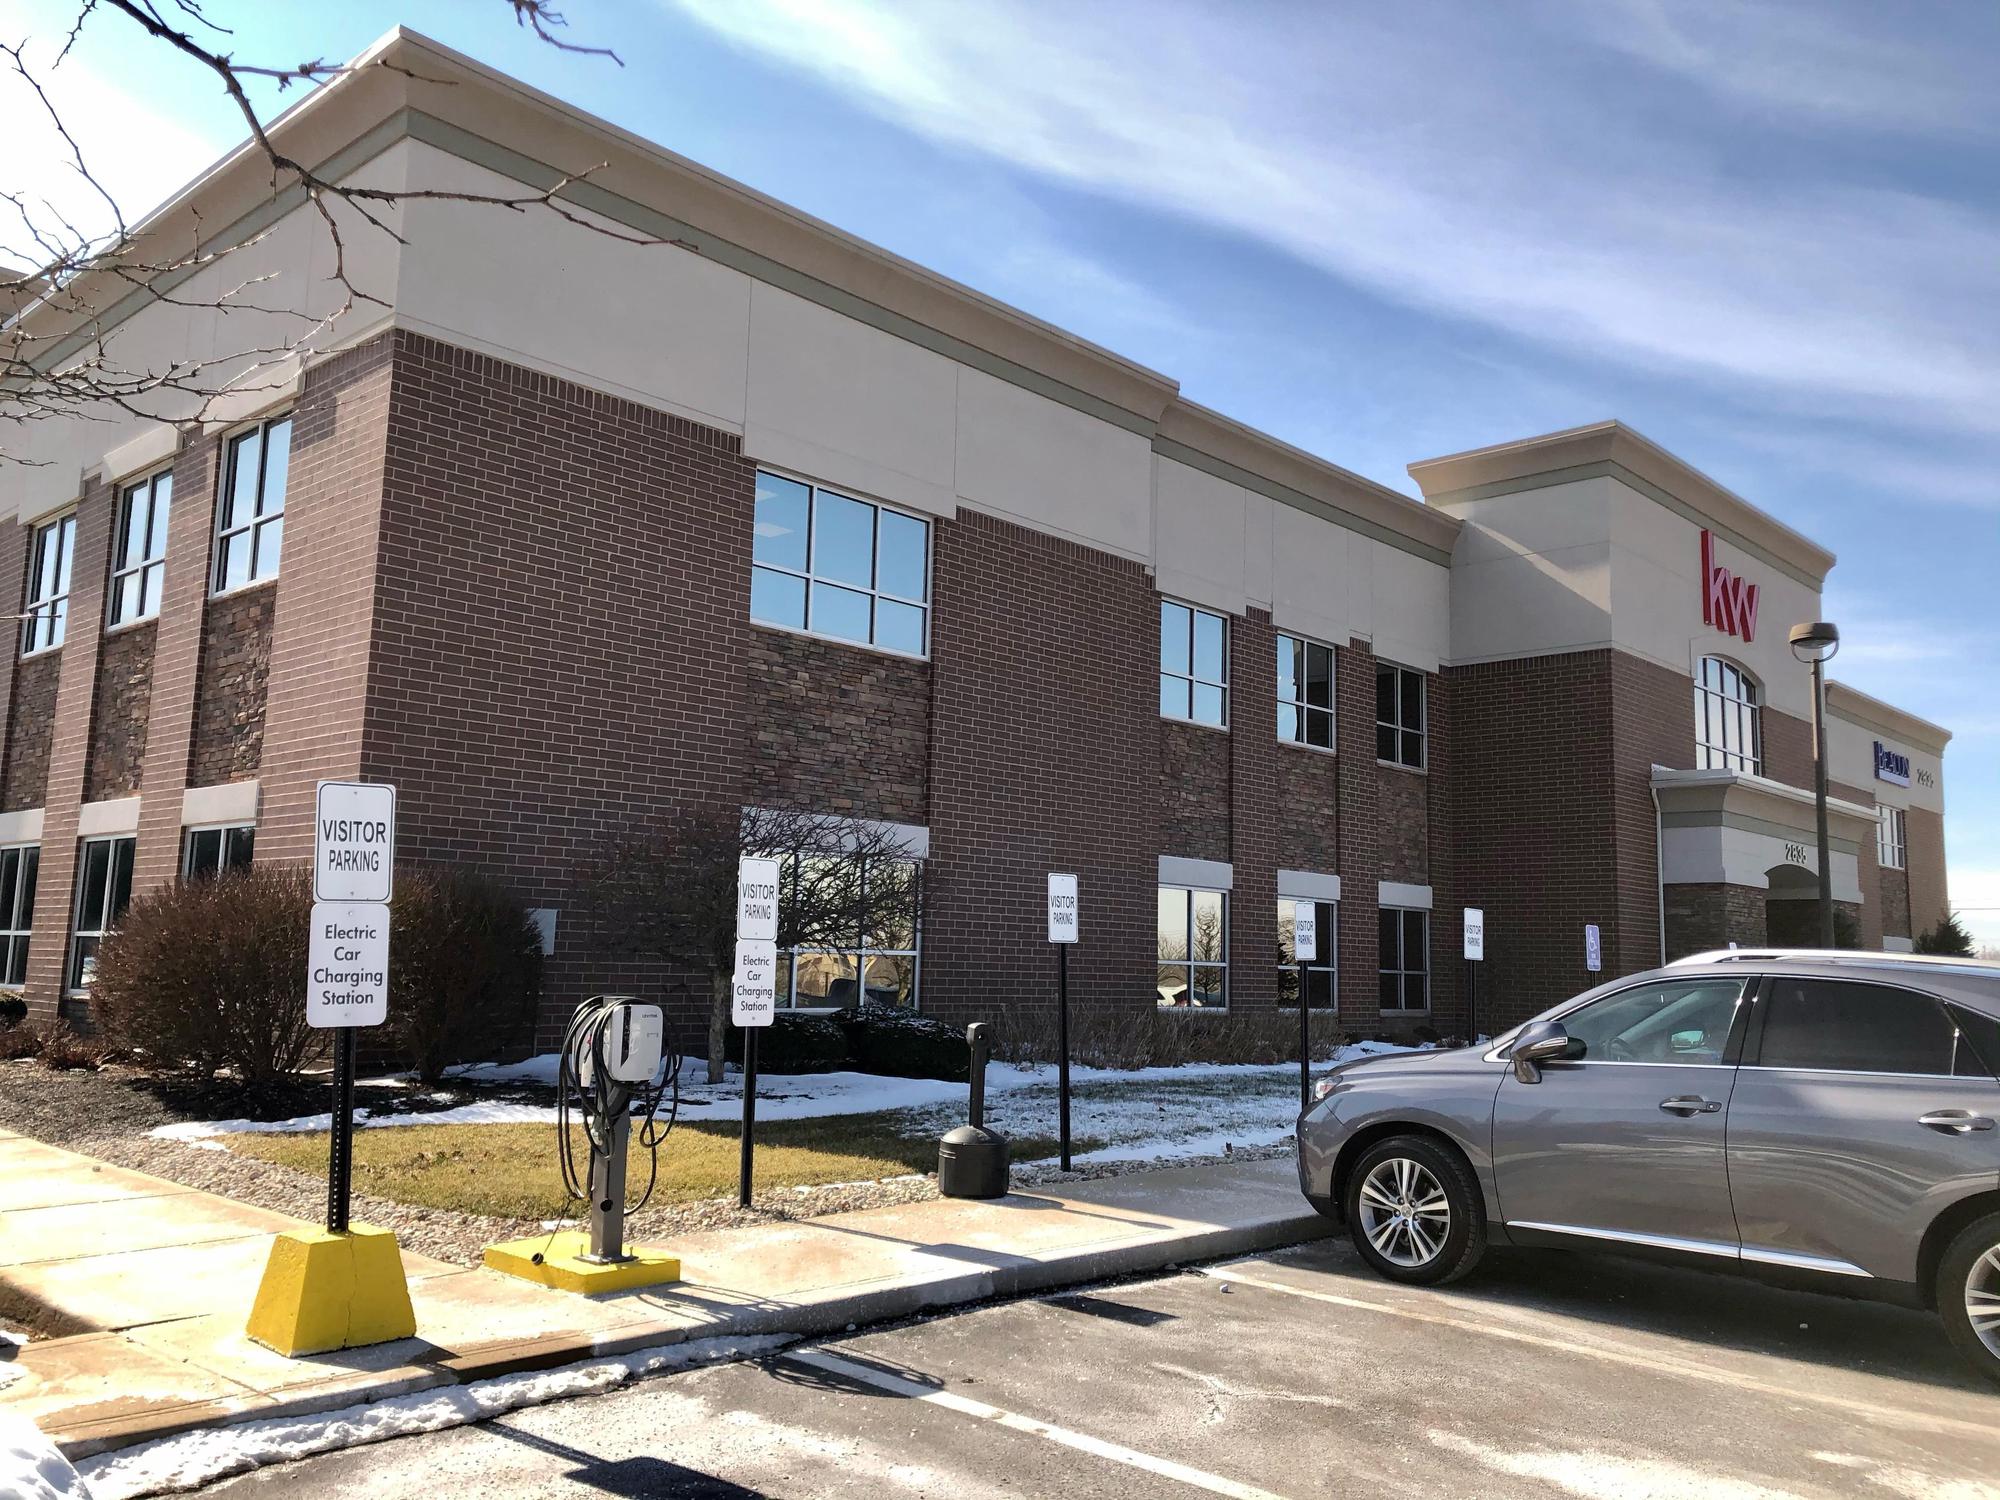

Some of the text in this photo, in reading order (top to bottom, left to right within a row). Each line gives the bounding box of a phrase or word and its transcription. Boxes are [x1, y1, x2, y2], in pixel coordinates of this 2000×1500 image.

[322, 819, 386, 843] VISITOR
[328, 849, 379, 872] PARKING
[742, 883, 775, 900] VISITOR
[1050, 895, 1075, 909] VISITOR
[744, 904, 771, 920] PARKING
[1053, 911, 1073, 925] PARKING
[325, 923, 377, 940] Electric
[1296, 920, 1314, 932] VISITOR
[1466, 924, 1482, 936] VISITOR
[1298, 934, 1313, 945] PARKING
[333, 946, 361, 961] Car
[742, 955, 770, 967] Electric
[313, 968, 383, 987] Charging
[747, 970, 762, 981] Car
[322, 990, 374, 1006] Station
[736, 985, 773, 999] Charging
[740, 1001, 768, 1012] Station
